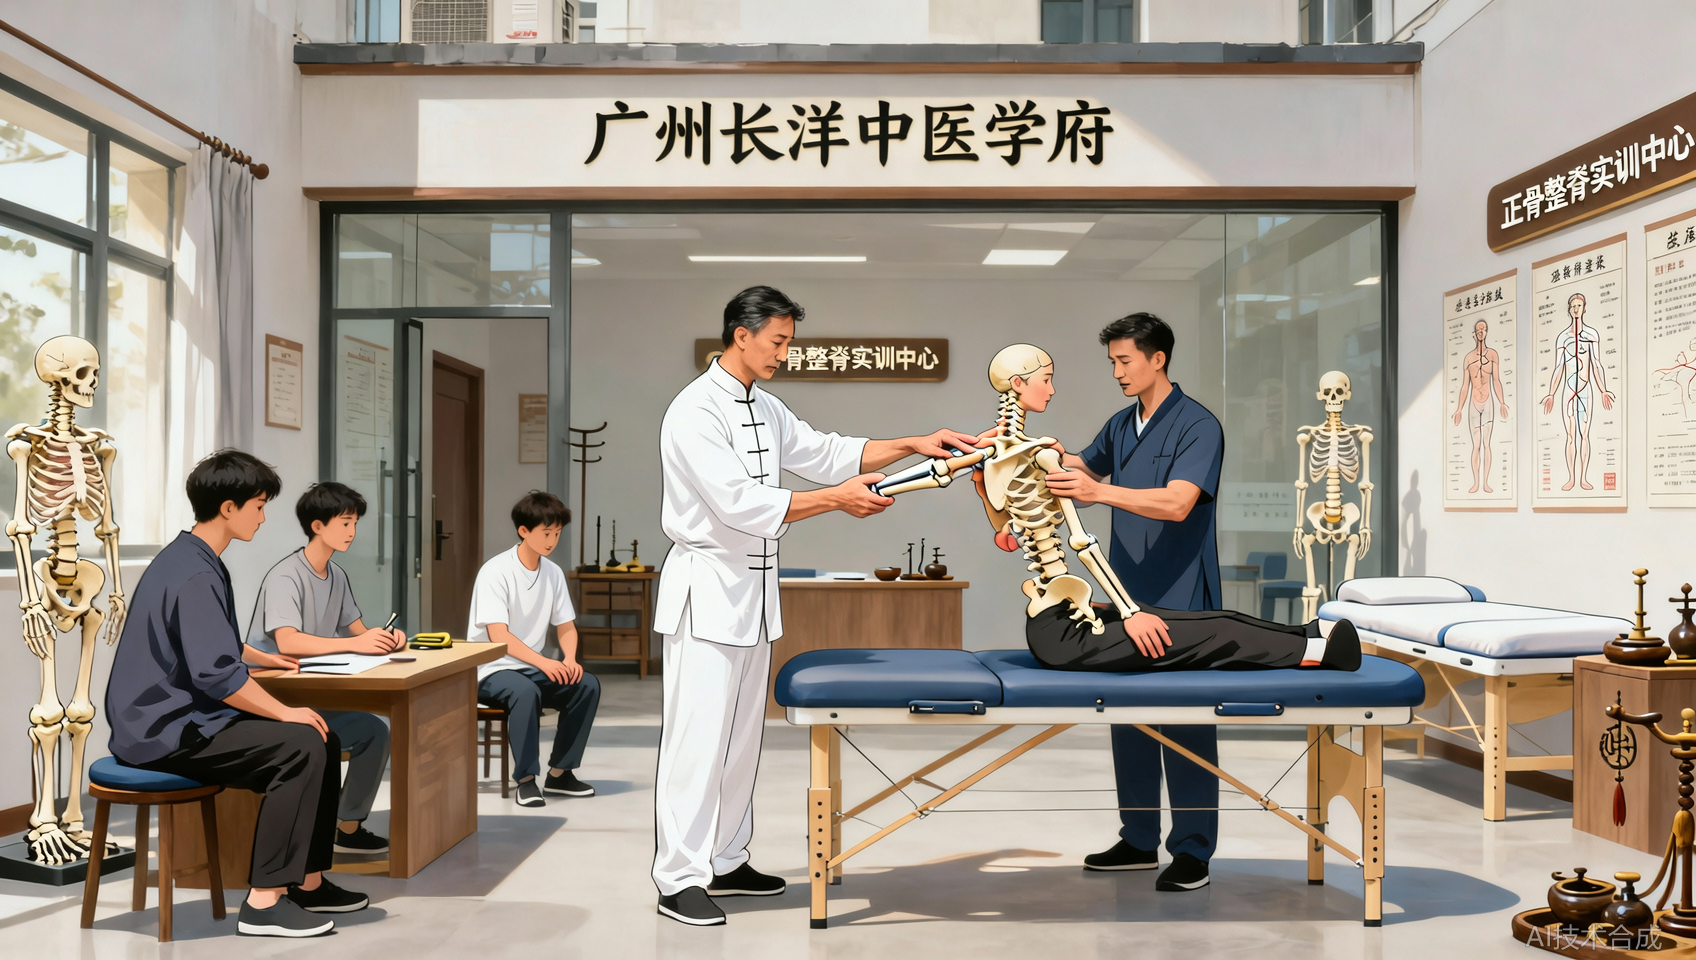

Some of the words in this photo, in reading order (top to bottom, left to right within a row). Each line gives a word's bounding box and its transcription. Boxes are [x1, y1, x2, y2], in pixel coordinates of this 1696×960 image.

[584, 100, 1114, 167] 广州长洋中医学府
[1500, 125, 1696, 230] 正骨整脊实训中心
